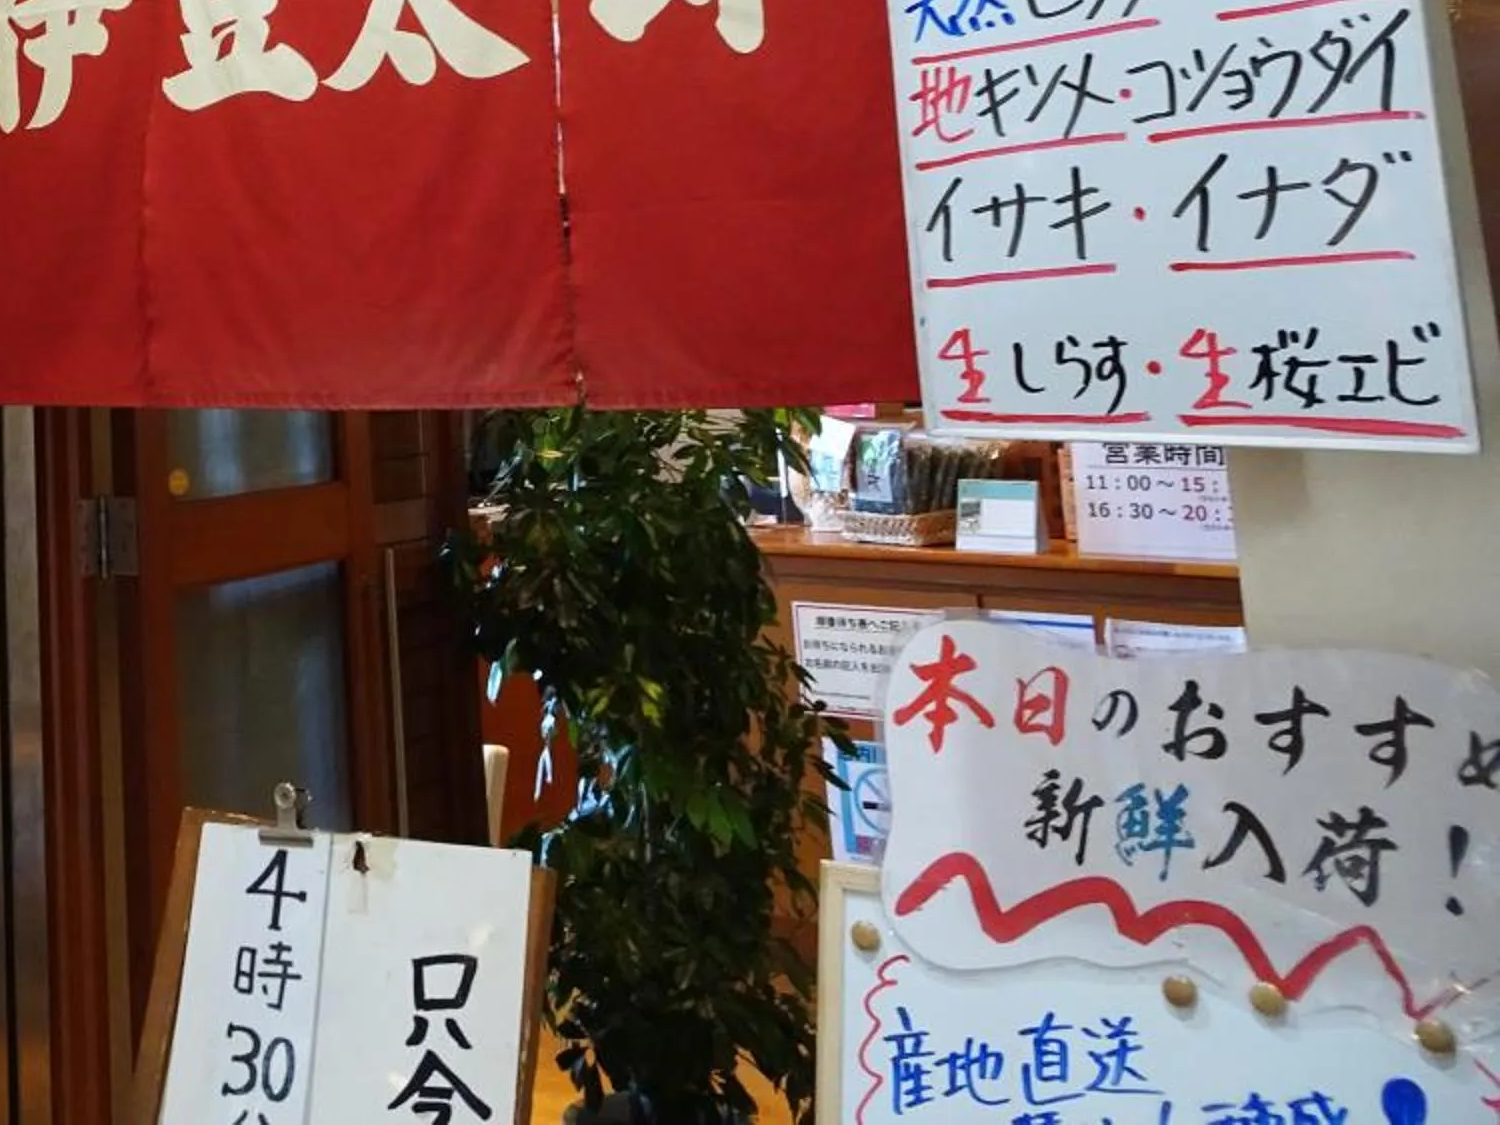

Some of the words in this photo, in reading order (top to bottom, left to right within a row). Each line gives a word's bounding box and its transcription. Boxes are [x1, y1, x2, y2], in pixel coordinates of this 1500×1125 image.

[1101, 442, 1225, 466] 営業時間
[1023, 767, 1470, 917] 新鮮入荷!
[221, 849, 308, 1125] 4時30
[387, 953, 493, 1125] 只今
[883, 1005, 1165, 1115] 産地直送
